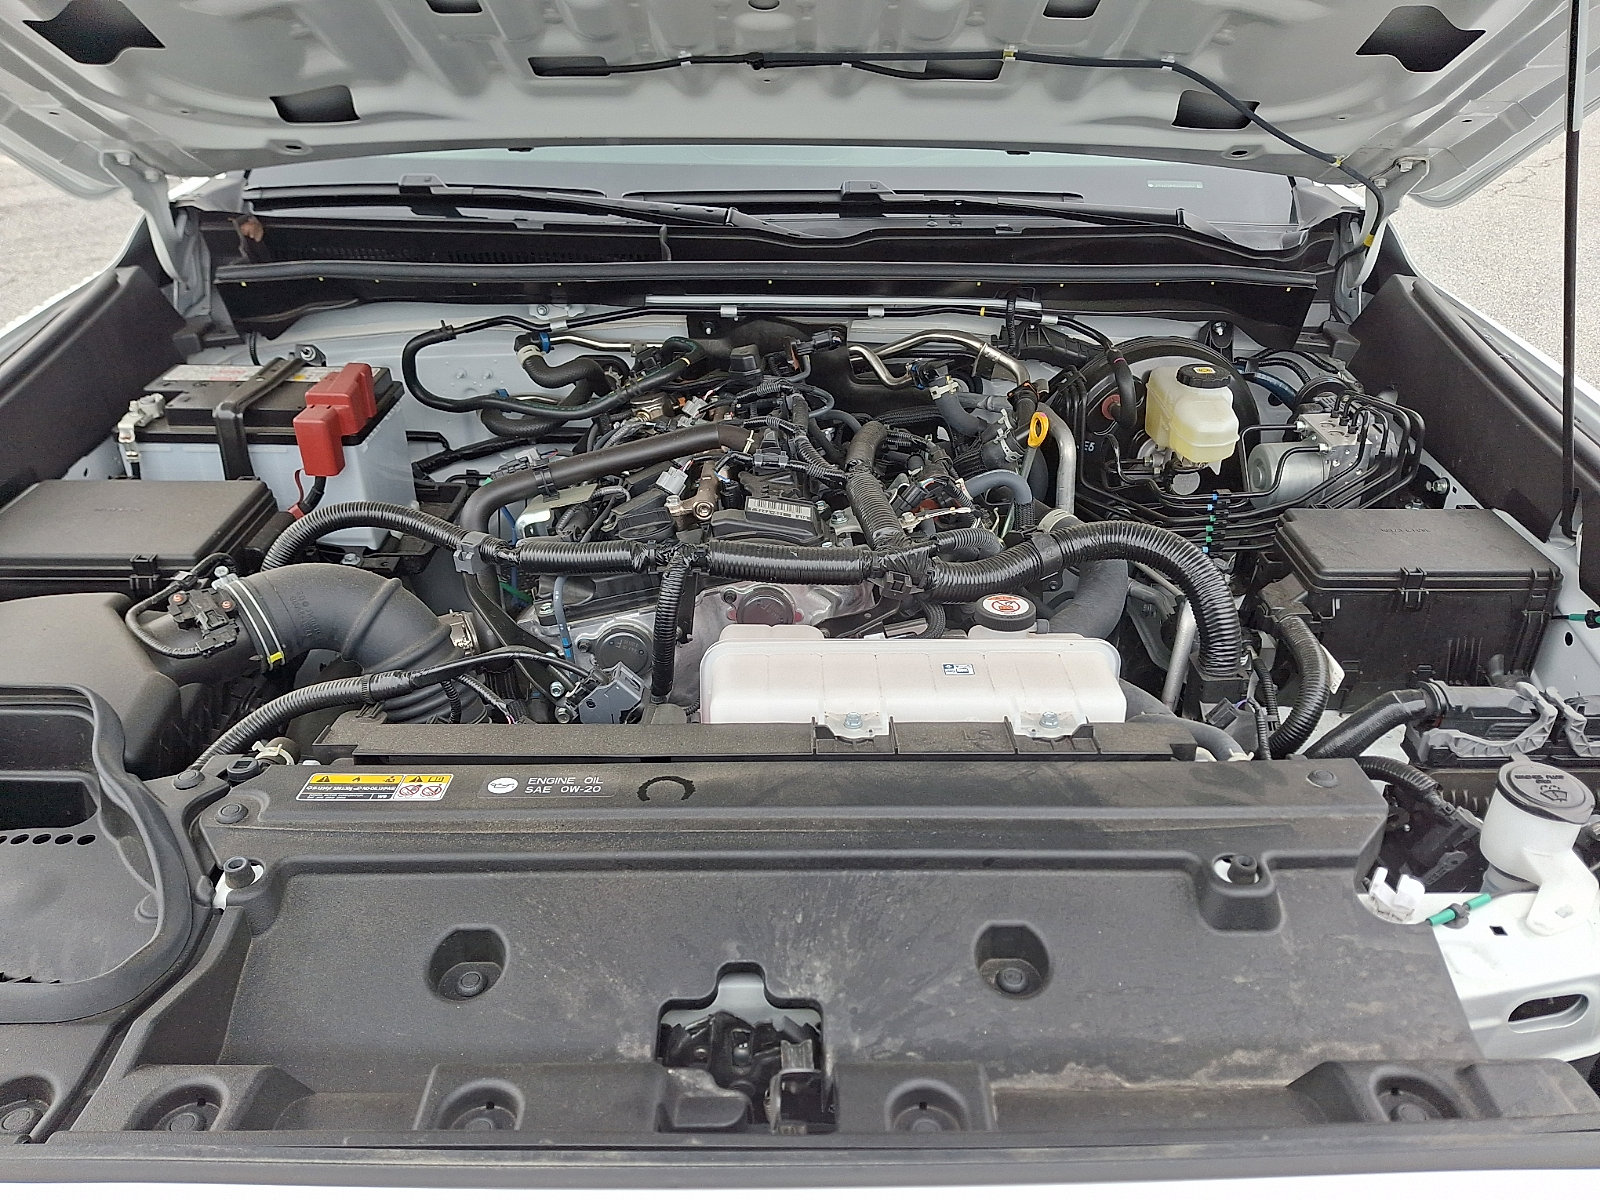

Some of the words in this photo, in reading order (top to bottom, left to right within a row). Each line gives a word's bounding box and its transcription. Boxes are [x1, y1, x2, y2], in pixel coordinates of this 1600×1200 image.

[527, 776, 576, 785] ENGINE
[583, 776, 604, 784] OIL
[524, 785, 553, 794] SAE
[560, 785, 602, 793] 0W-20
